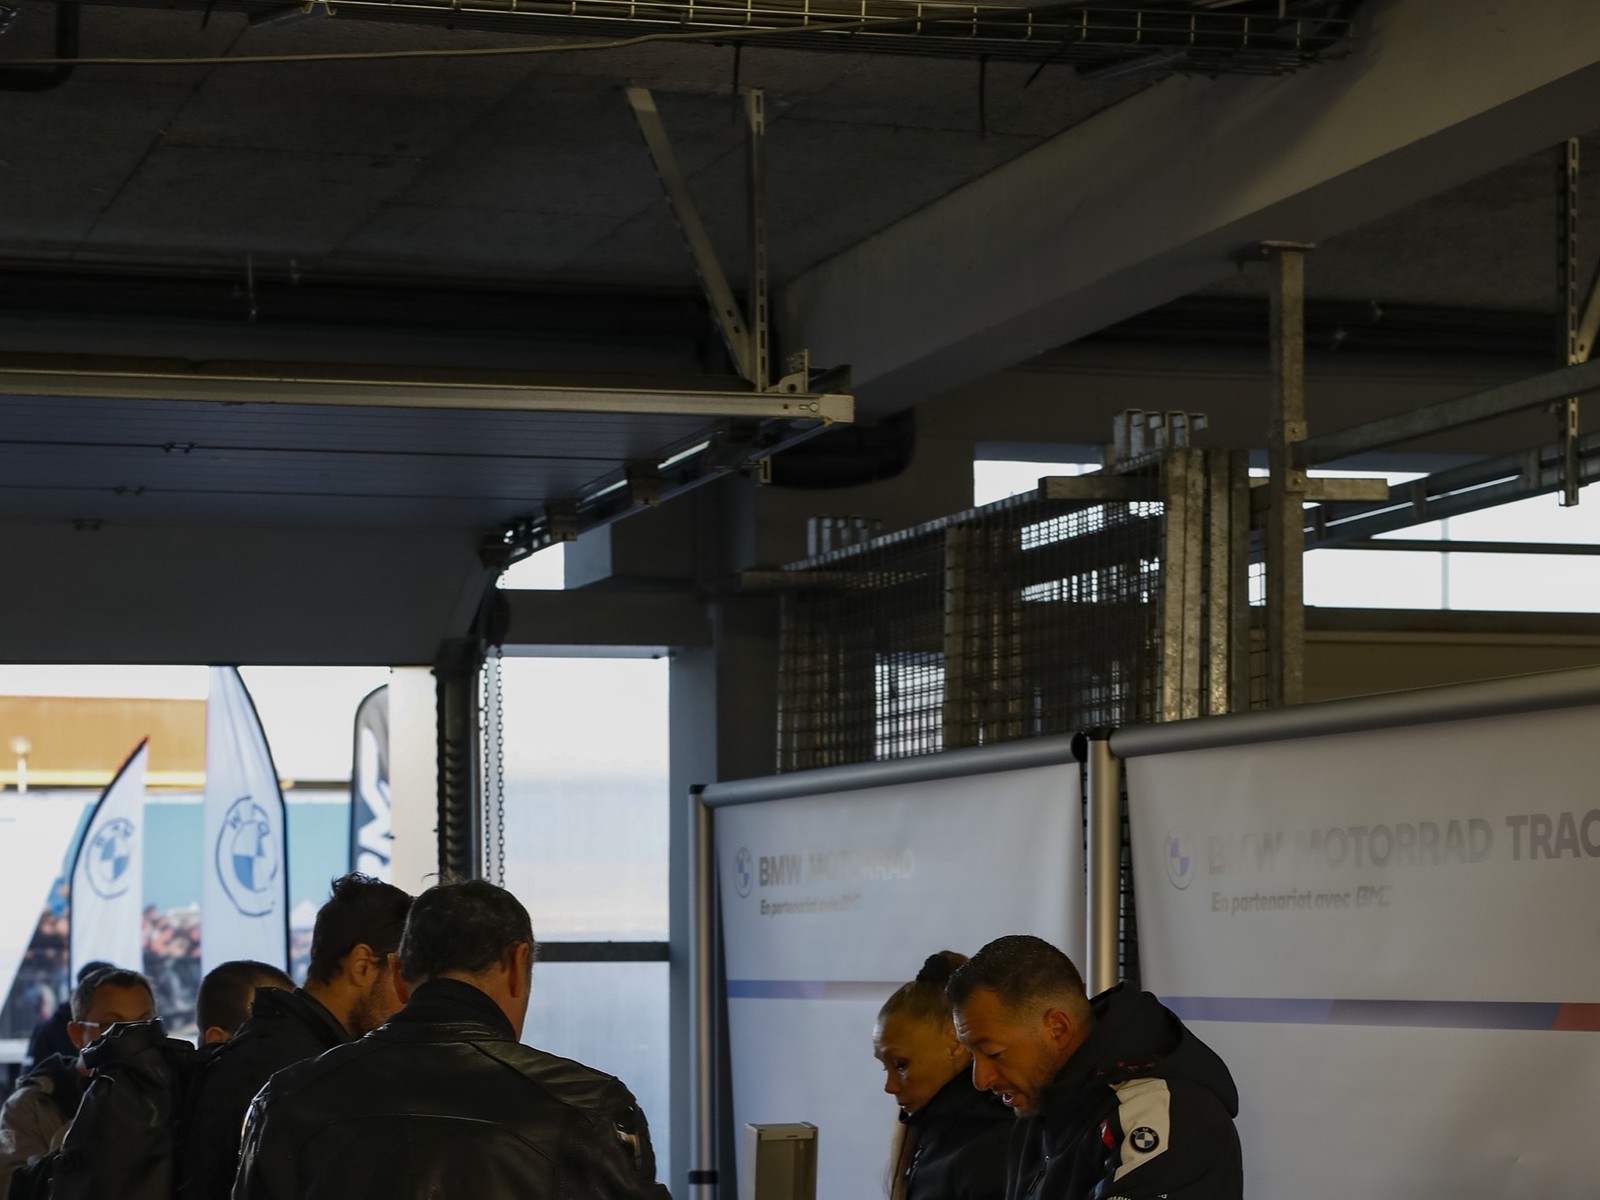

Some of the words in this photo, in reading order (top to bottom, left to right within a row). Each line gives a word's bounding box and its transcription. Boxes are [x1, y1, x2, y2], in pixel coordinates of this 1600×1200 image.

[1296, 818, 1495, 871] MOTORRAD
[758, 853, 802, 887] BMW
[1211, 892, 1229, 913] En
[1231, 888, 1313, 917] partenariat
[1314, 892, 1351, 910] avec
